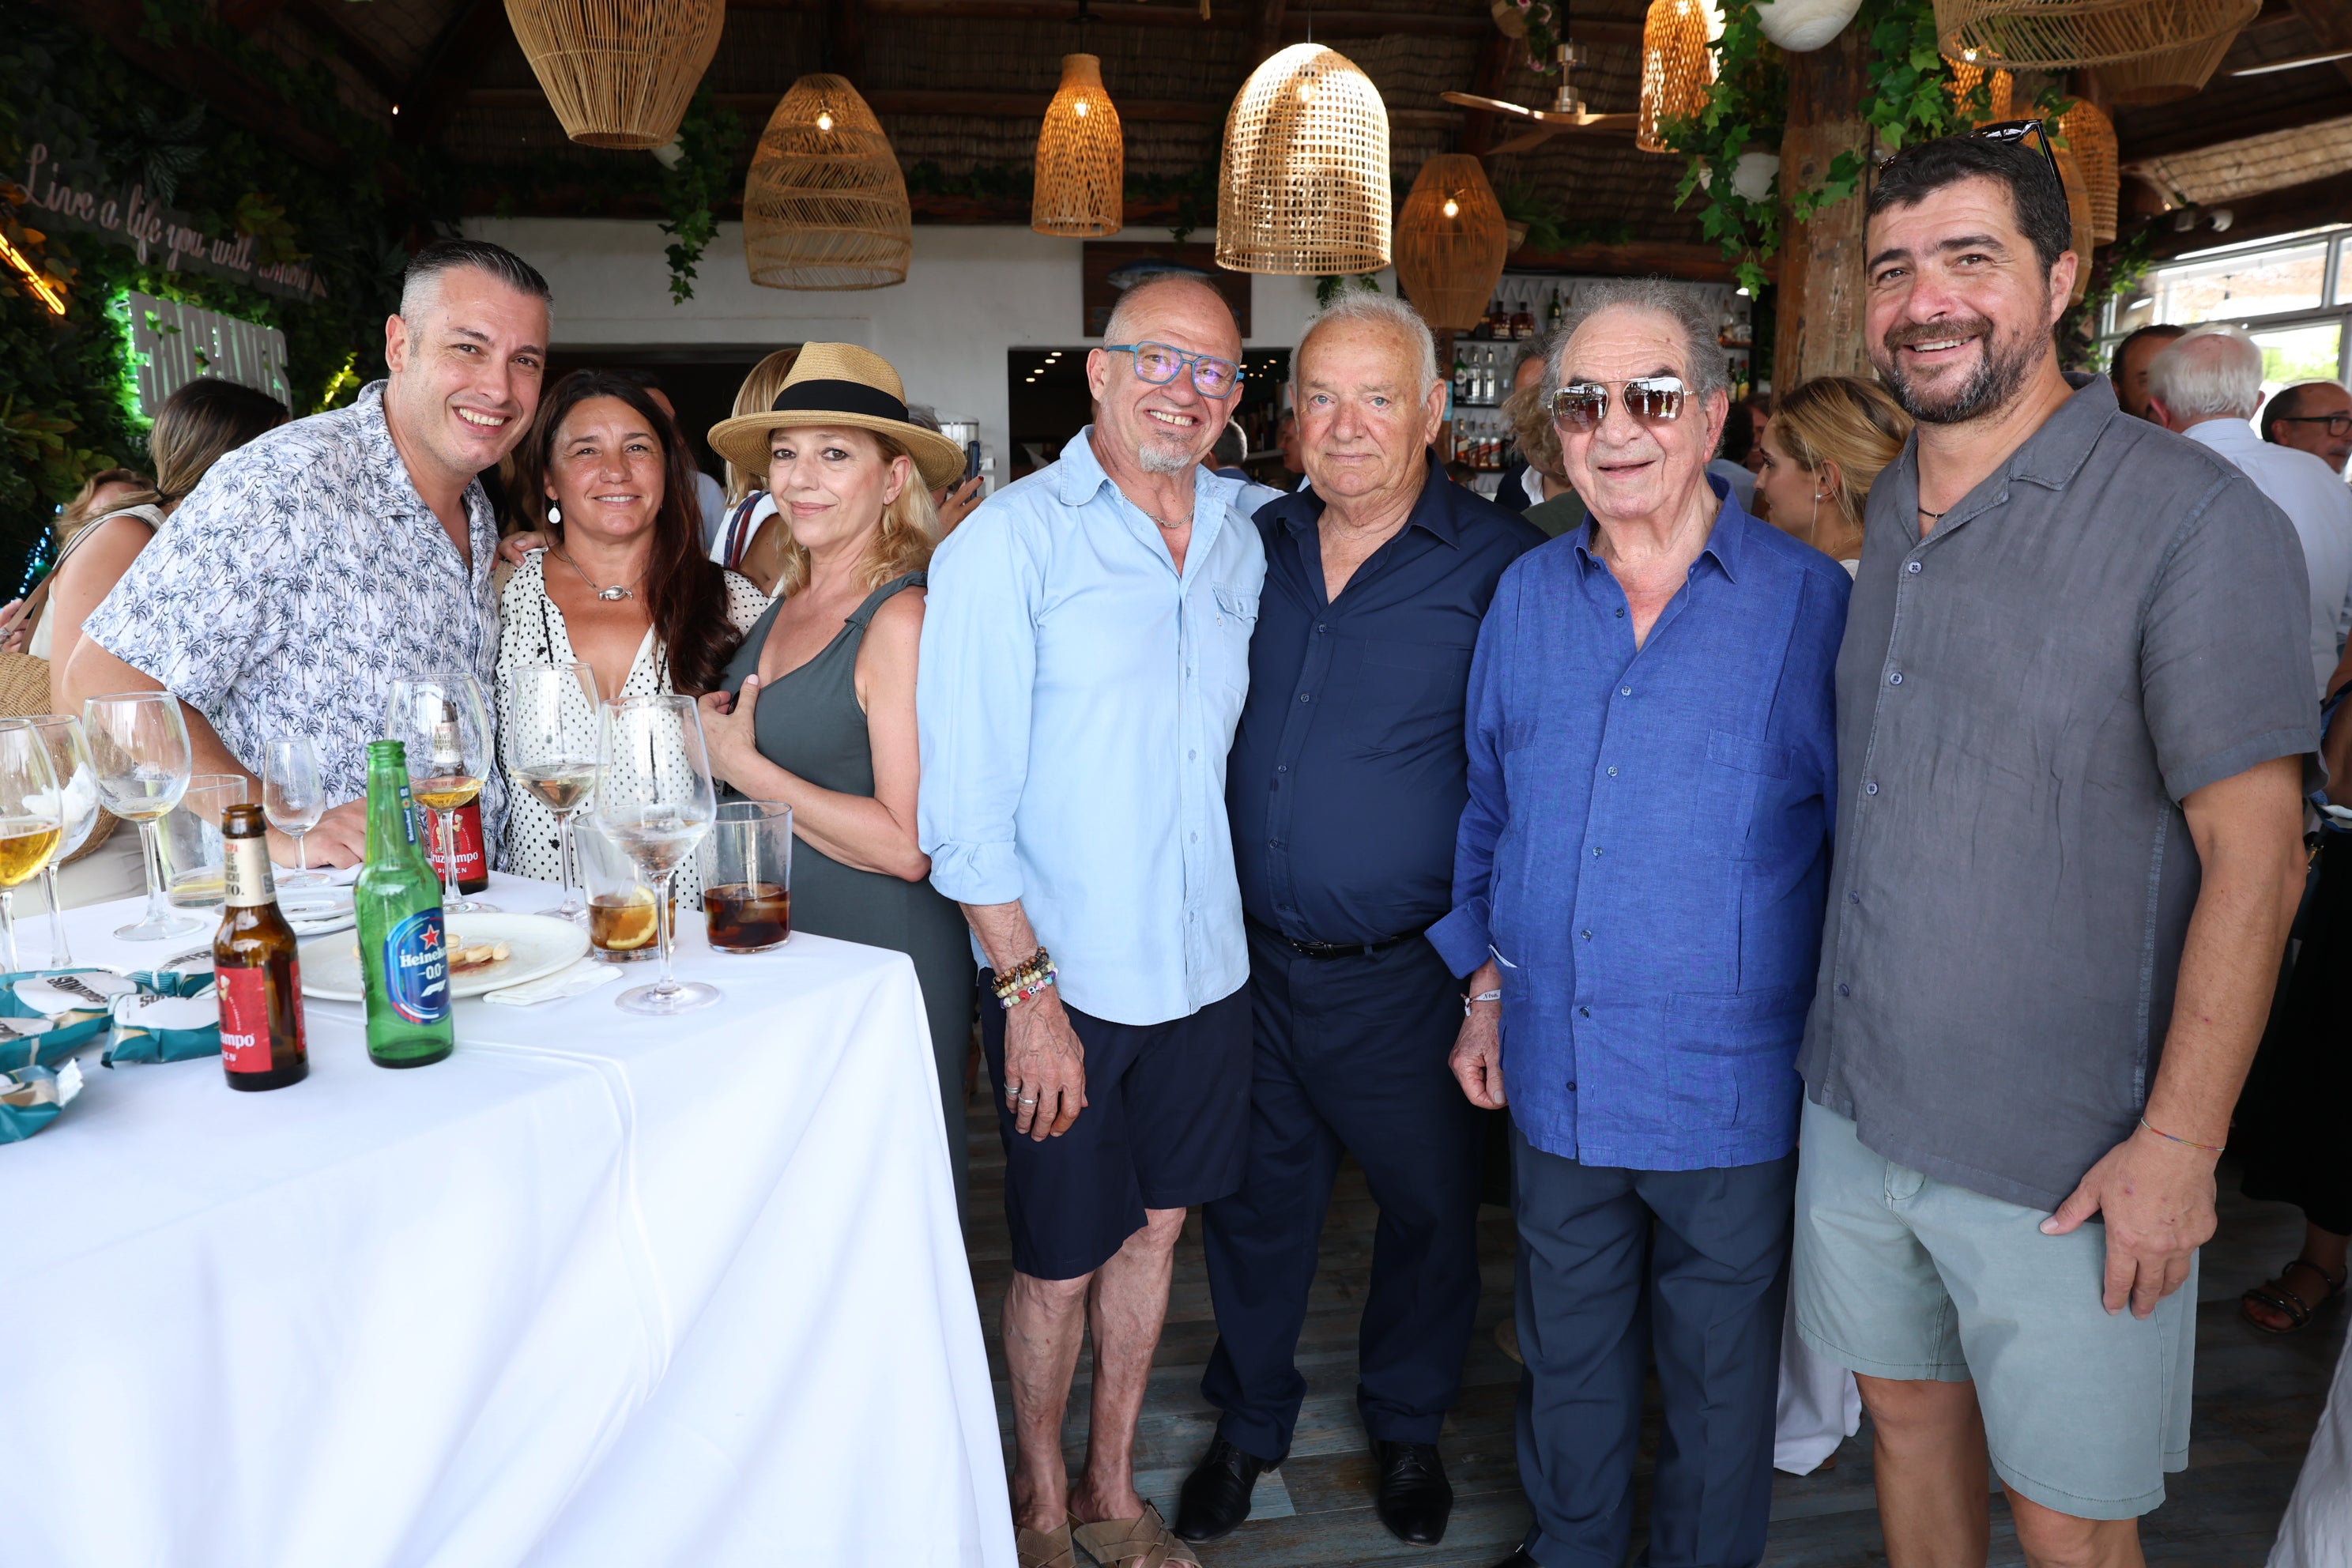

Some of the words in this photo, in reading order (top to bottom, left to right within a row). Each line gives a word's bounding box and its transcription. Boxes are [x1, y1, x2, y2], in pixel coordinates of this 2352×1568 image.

[15, 143, 95, 221] Live
[100, 199, 121, 230] a
[126, 184, 162, 266] life
[166, 223, 206, 271] you
[431, 851, 479, 864] ruzmpo
